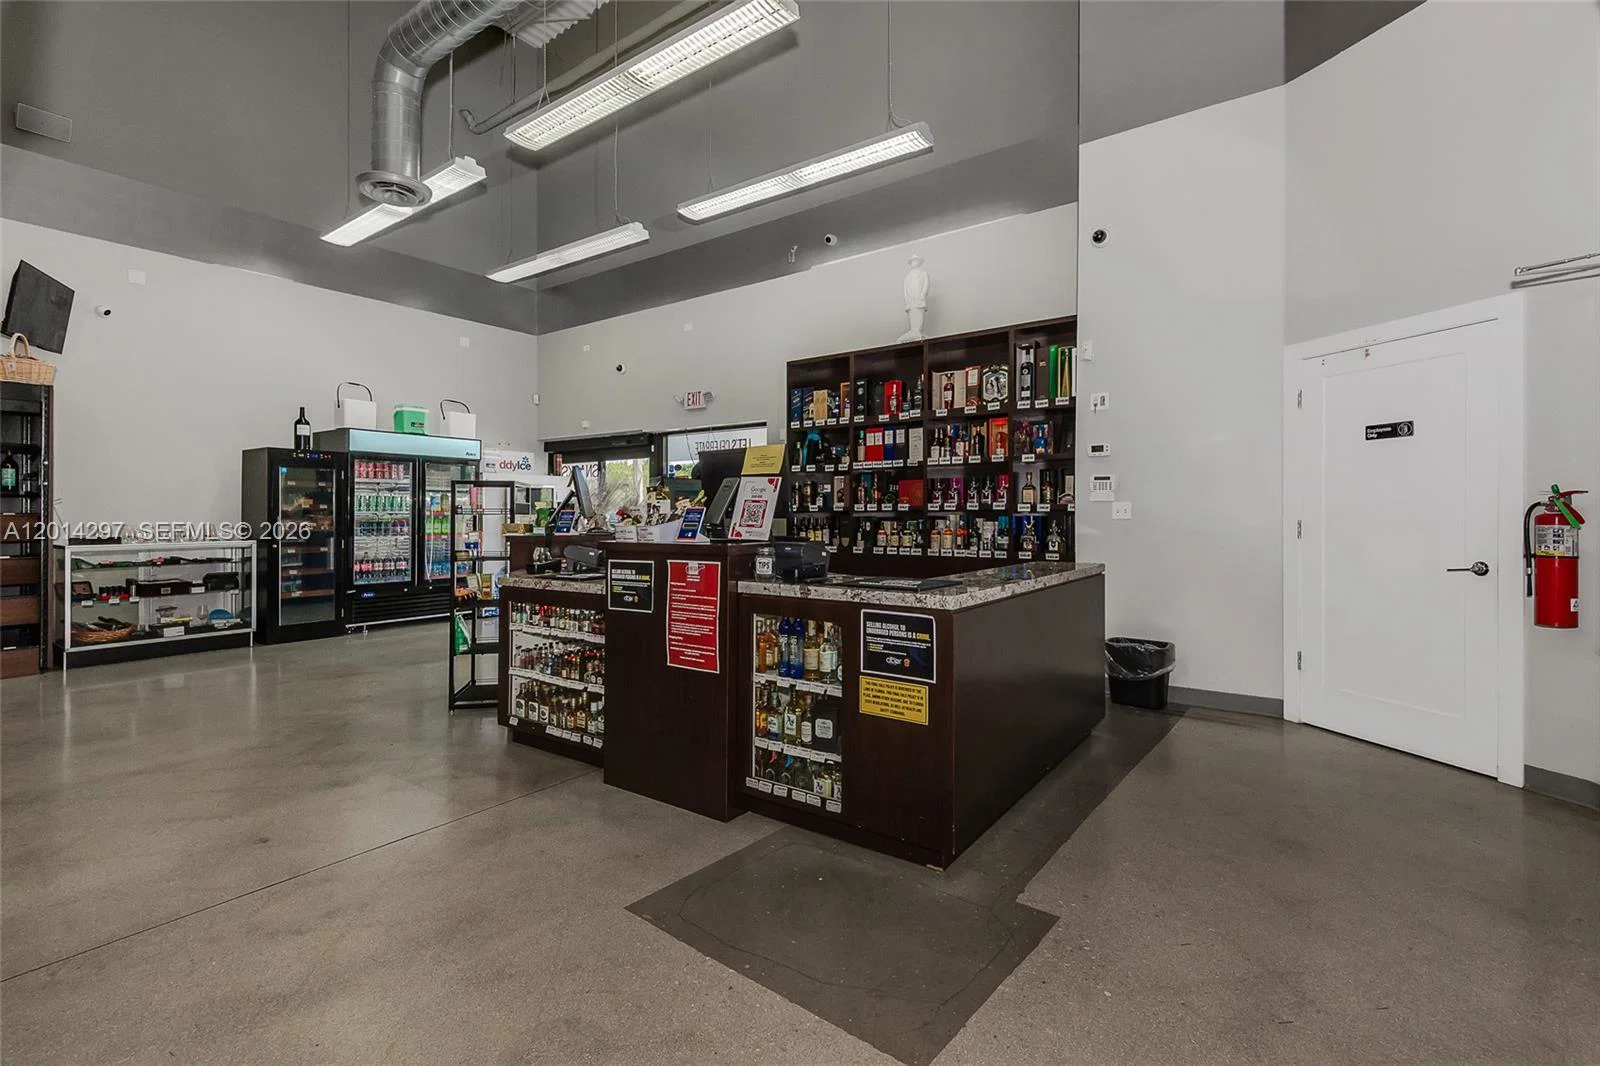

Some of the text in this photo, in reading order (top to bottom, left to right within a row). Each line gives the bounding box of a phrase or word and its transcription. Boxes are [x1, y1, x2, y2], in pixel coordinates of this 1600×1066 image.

[687, 391, 702, 407] EXIT
[499, 459, 532, 474] ddyIce
[758, 561, 770, 570] TIPS
